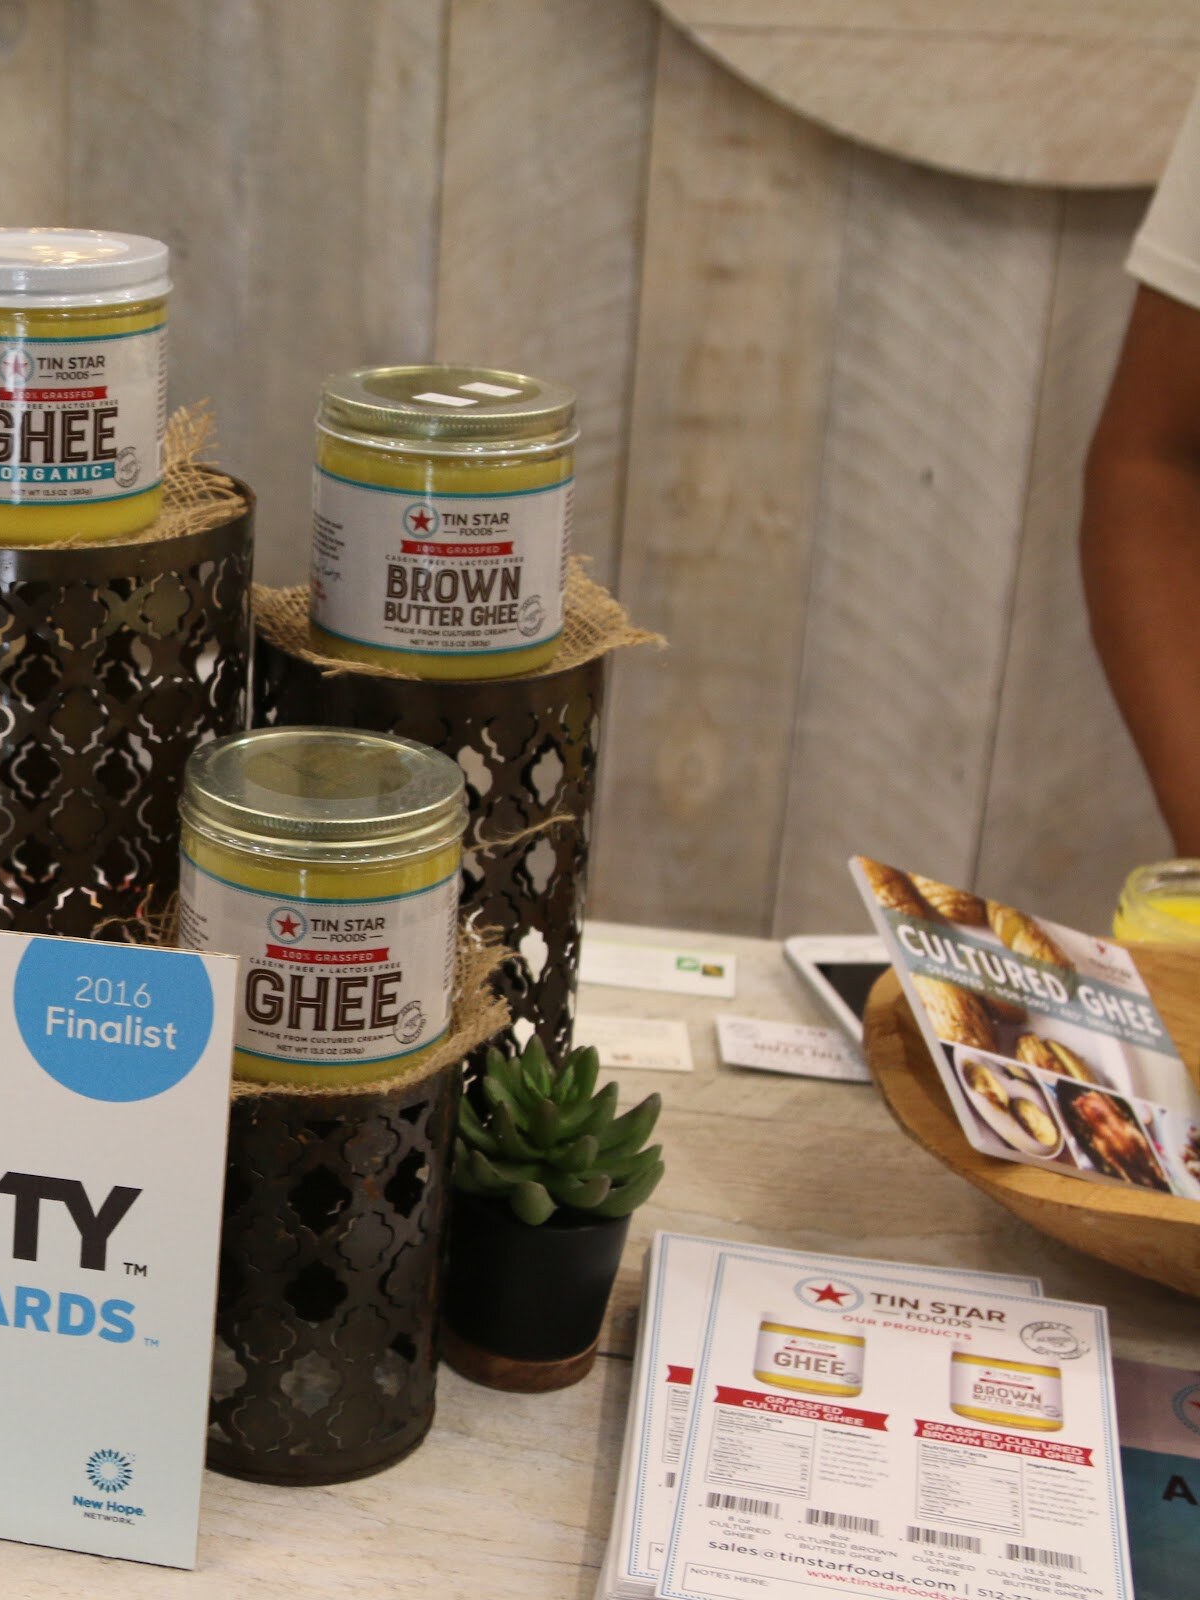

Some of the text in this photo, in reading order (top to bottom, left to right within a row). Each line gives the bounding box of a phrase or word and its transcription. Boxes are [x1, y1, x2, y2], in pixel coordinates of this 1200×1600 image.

[37, 355, 105, 370] TIN STAR
[56, 371, 89, 380] FOODS
[42, 390, 95, 400] GRASSFED
[56, 402, 96, 410] LACTOSE
[0, 465, 102, 481] ORGANIC
[442, 512, 510, 526] TIN STAR
[460, 528, 493, 536] FOODS
[446, 545, 500, 554] GRASSFED
[386, 564, 522, 604] BROWN
[384, 601, 463, 626] BUTTER
[471, 603, 519, 626] GHEE
[310, 917, 386, 933] TIN STAR
[330, 933, 367, 943] FOODS
[282, 950, 374, 962] 100% GRASSFED
[249, 957, 401, 974] CASEIN FREE LACTOSE FREE
[896, 923, 1070, 1005] CULTURED
[1077, 984, 1162, 1037] GHEE
[75, 975, 153, 1009] 2016
[245, 968, 403, 1032] GHEE
[45, 1006, 178, 1051] Finalist
[258, 1030, 281, 1039] MADE
[284, 1034, 307, 1042] FROM
[871, 1292, 1007, 1324] TIN STAR
[842, 1315, 973, 1341] OUR PRODUCTS
[906, 1311, 972, 1329] FOODS
[773, 1351, 846, 1377] GHEE
[973, 1384, 1042, 1404] BROWN
[743, 1399, 865, 1427] CULTURED GHEE
[765, 1395, 843, 1415] GRASSFED
[922, 1429, 1086, 1464] BROWN BUTTER GHEE
[924, 1422, 1083, 1456] GRASSFED CULTURED
[72, 1495, 144, 1516] New Hope
[84, 1512, 133, 1525] NETWORK
[709, 1520, 772, 1535] CULTURED
[722, 1529, 755, 1540] GHEE
[784, 1532, 898, 1558] CULTURED BROWN
[799, 1543, 845, 1556] BUTTER
[708, 1539, 956, 1592] sales@tinstarfoods.com
[911, 1554, 976, 1572] CULTURED
[690, 1567, 731, 1581] NOTES
[987, 1568, 1103, 1595] CULTURED BROWN
[1002, 1579, 1051, 1593] BUTTER
